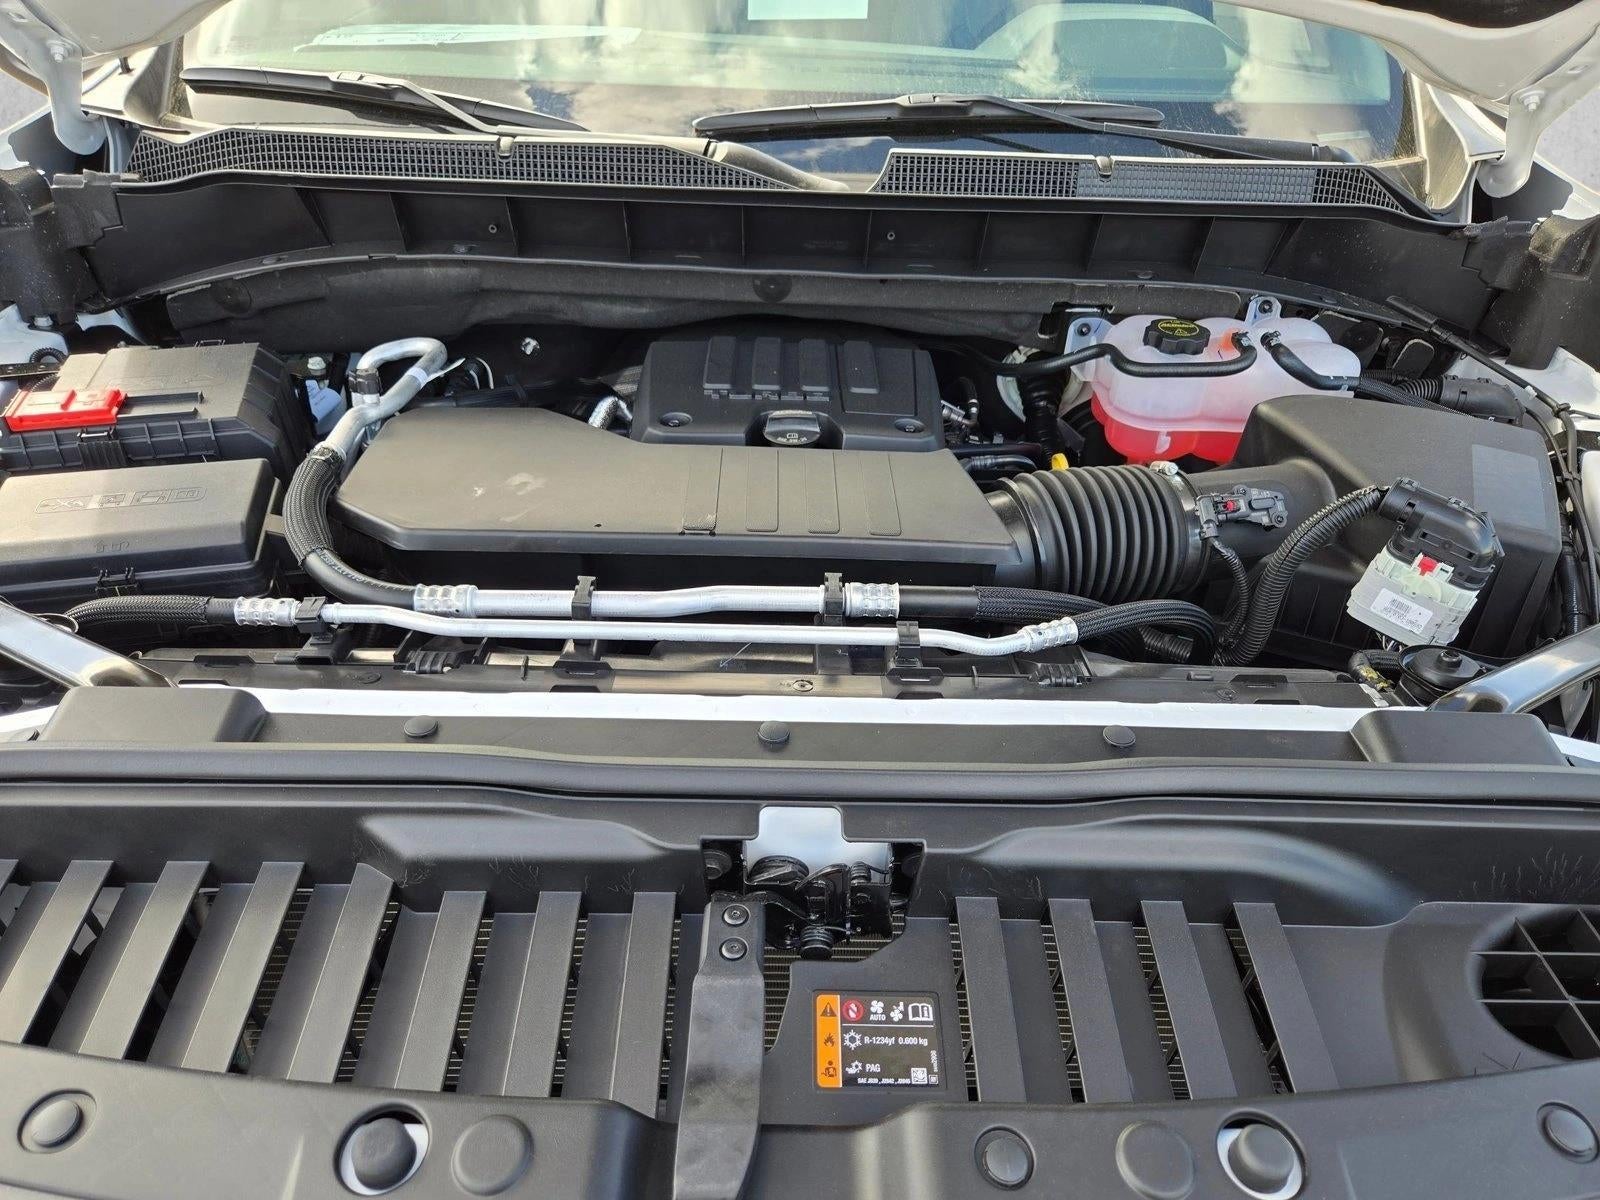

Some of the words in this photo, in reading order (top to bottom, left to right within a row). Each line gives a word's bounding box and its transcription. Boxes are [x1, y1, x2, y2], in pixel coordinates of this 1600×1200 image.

[864, 1036, 896, 1046] R-1234yf
[918, 1036, 928, 1047] kg
[865, 1064, 881, 1072] PAG
